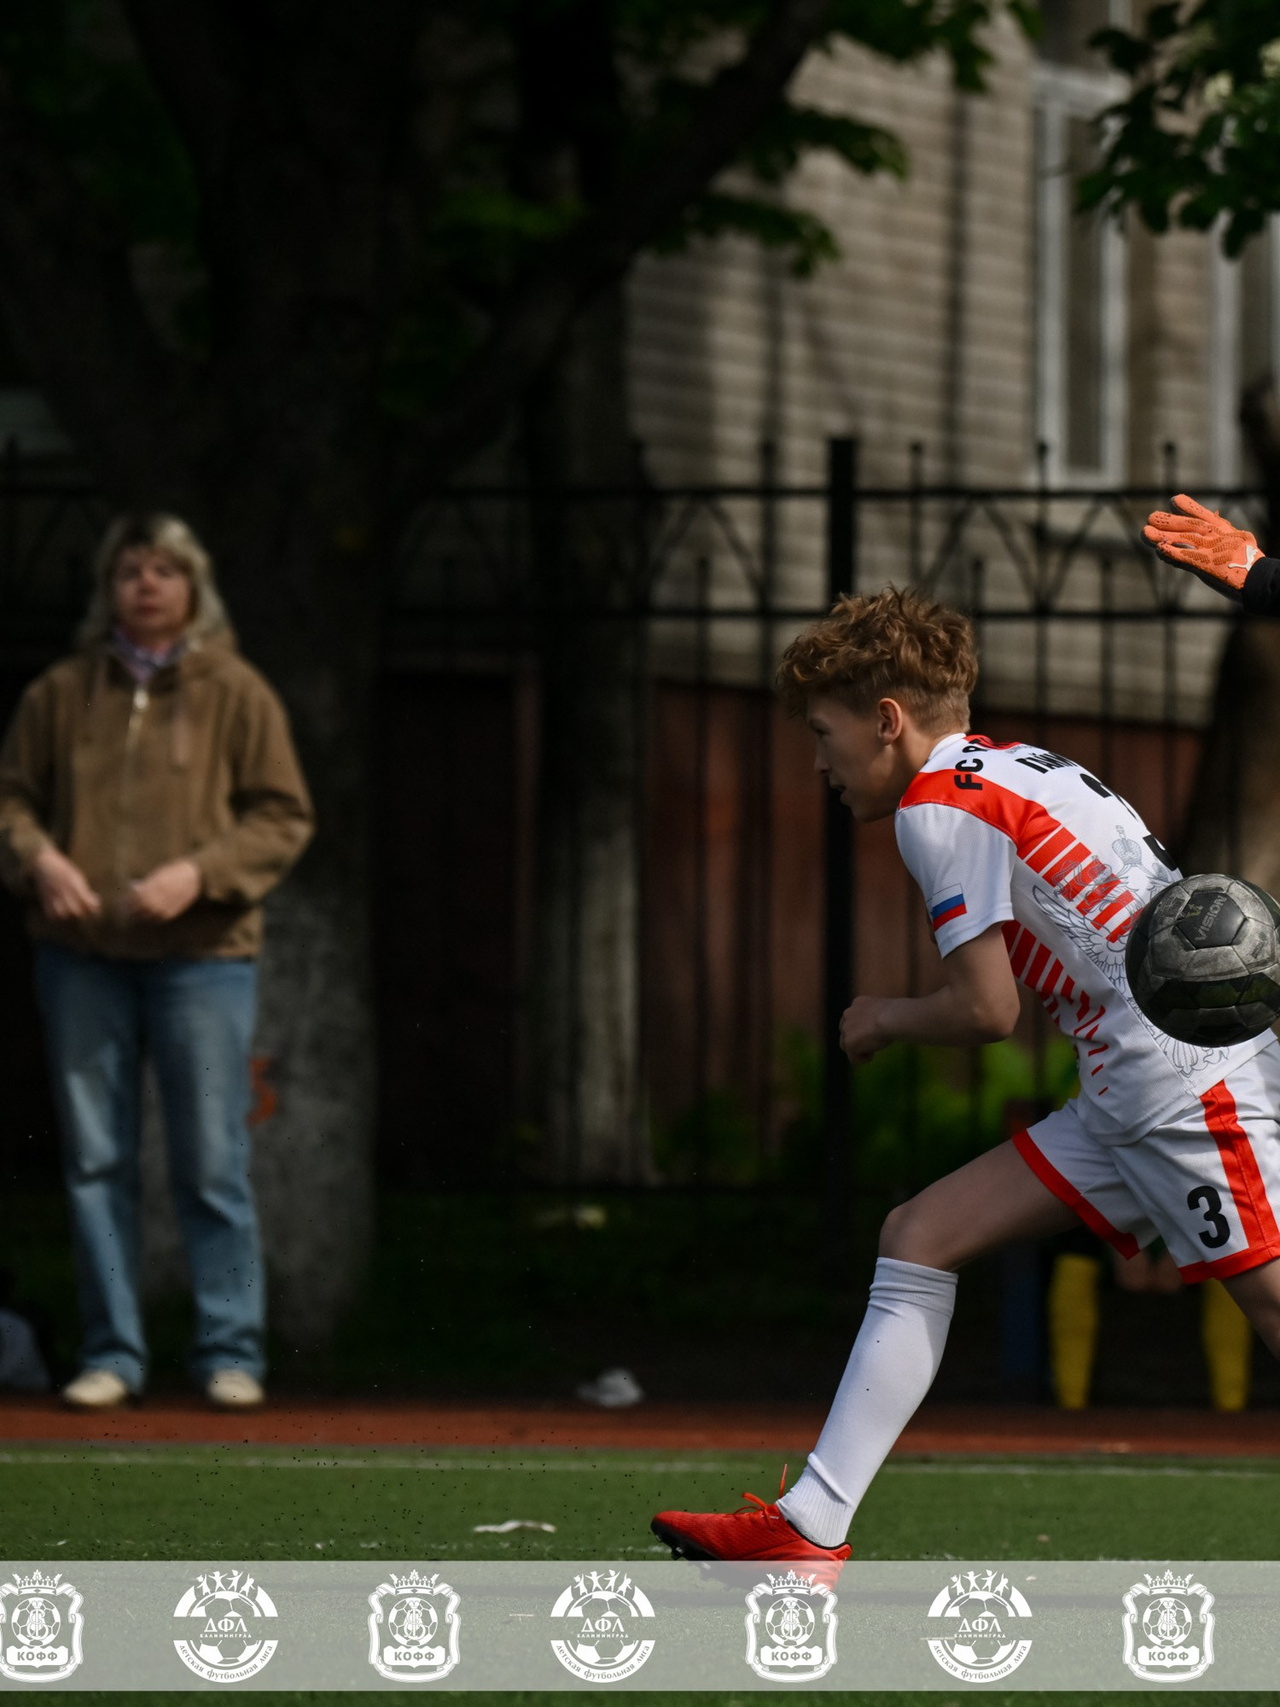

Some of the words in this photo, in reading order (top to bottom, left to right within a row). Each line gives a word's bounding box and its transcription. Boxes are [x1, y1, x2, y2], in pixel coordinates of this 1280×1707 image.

[954, 758, 984, 790] FC
[1194, 895, 1228, 941] VISION
[1187, 1185, 1231, 1249] 3
